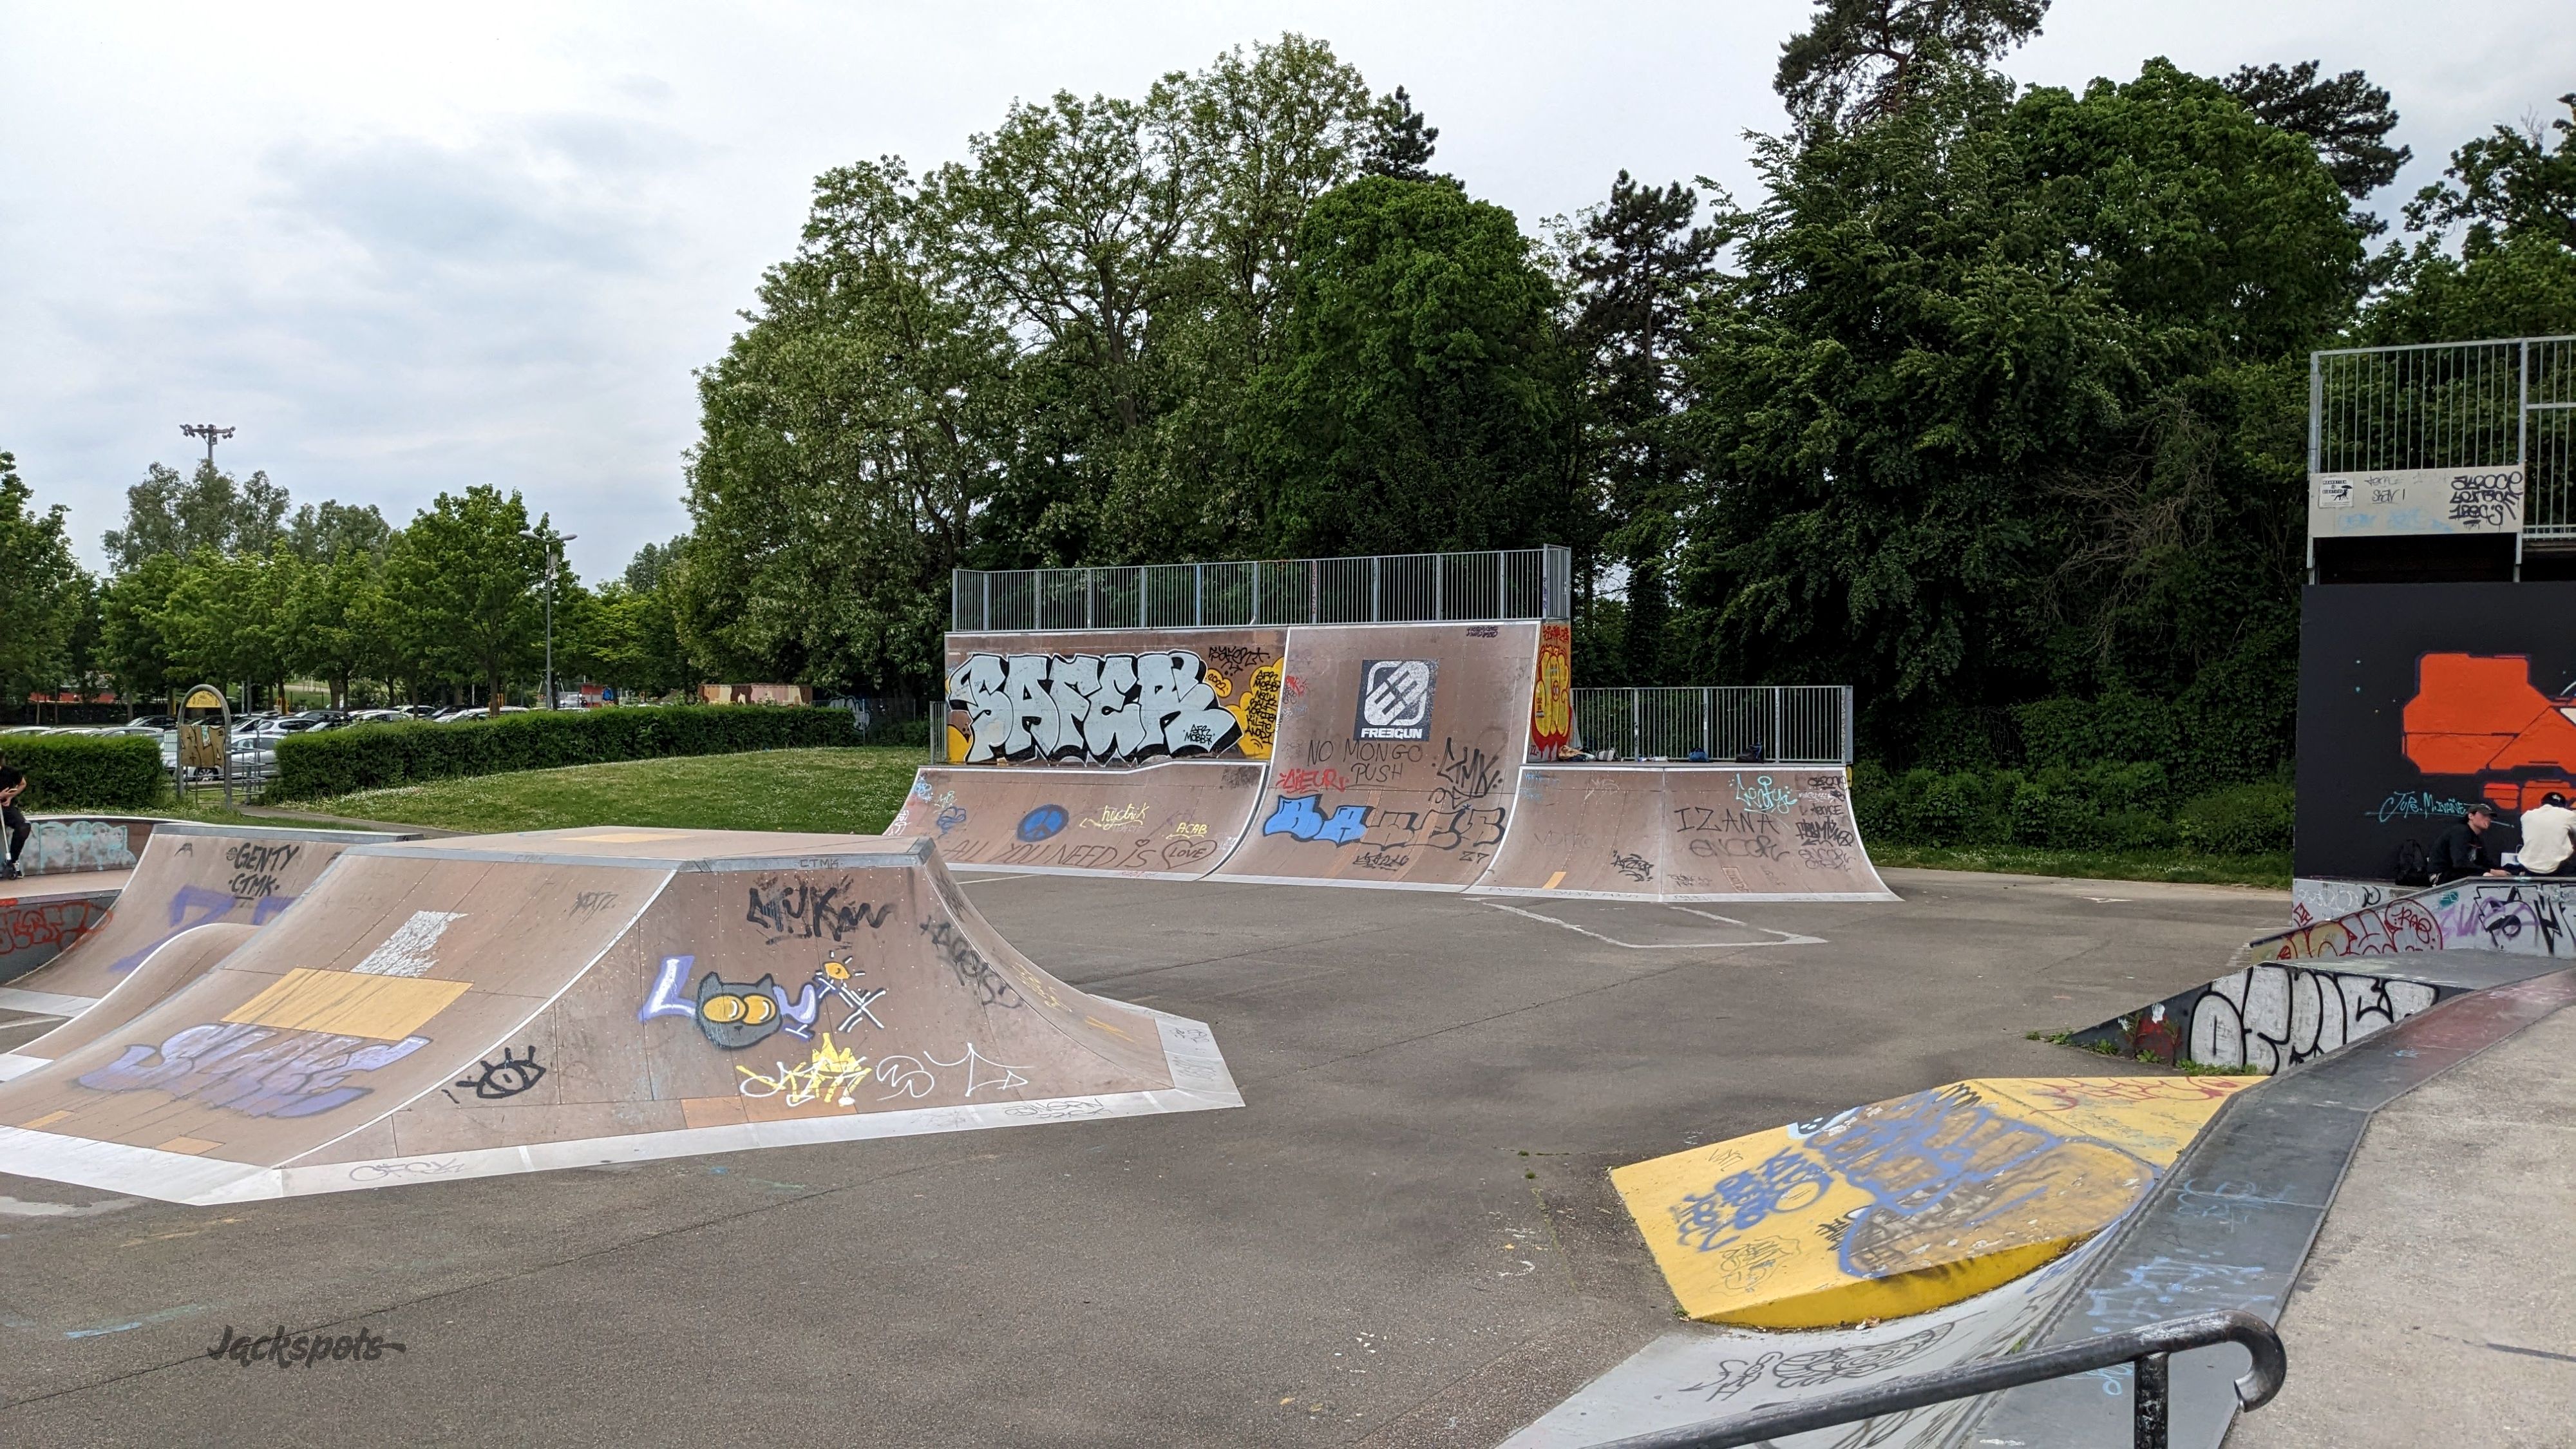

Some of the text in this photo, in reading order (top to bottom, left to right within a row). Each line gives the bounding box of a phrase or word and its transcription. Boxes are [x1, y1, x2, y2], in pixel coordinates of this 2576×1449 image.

[949, 650, 1243, 764] SAFER
[1361, 728, 1423, 739] FREEGUN
[1308, 739, 1423, 766] NO MONGO
[1351, 762, 1404, 784] PUSH
[1176, 822, 1208, 835] ACAB
[1674, 806, 1780, 835] IZANA
[942, 839, 989, 862] ALL
[988, 842, 1050, 864] YOU
[1043, 843, 1118, 868] NEED
[1169, 848, 1208, 859] LOVE
